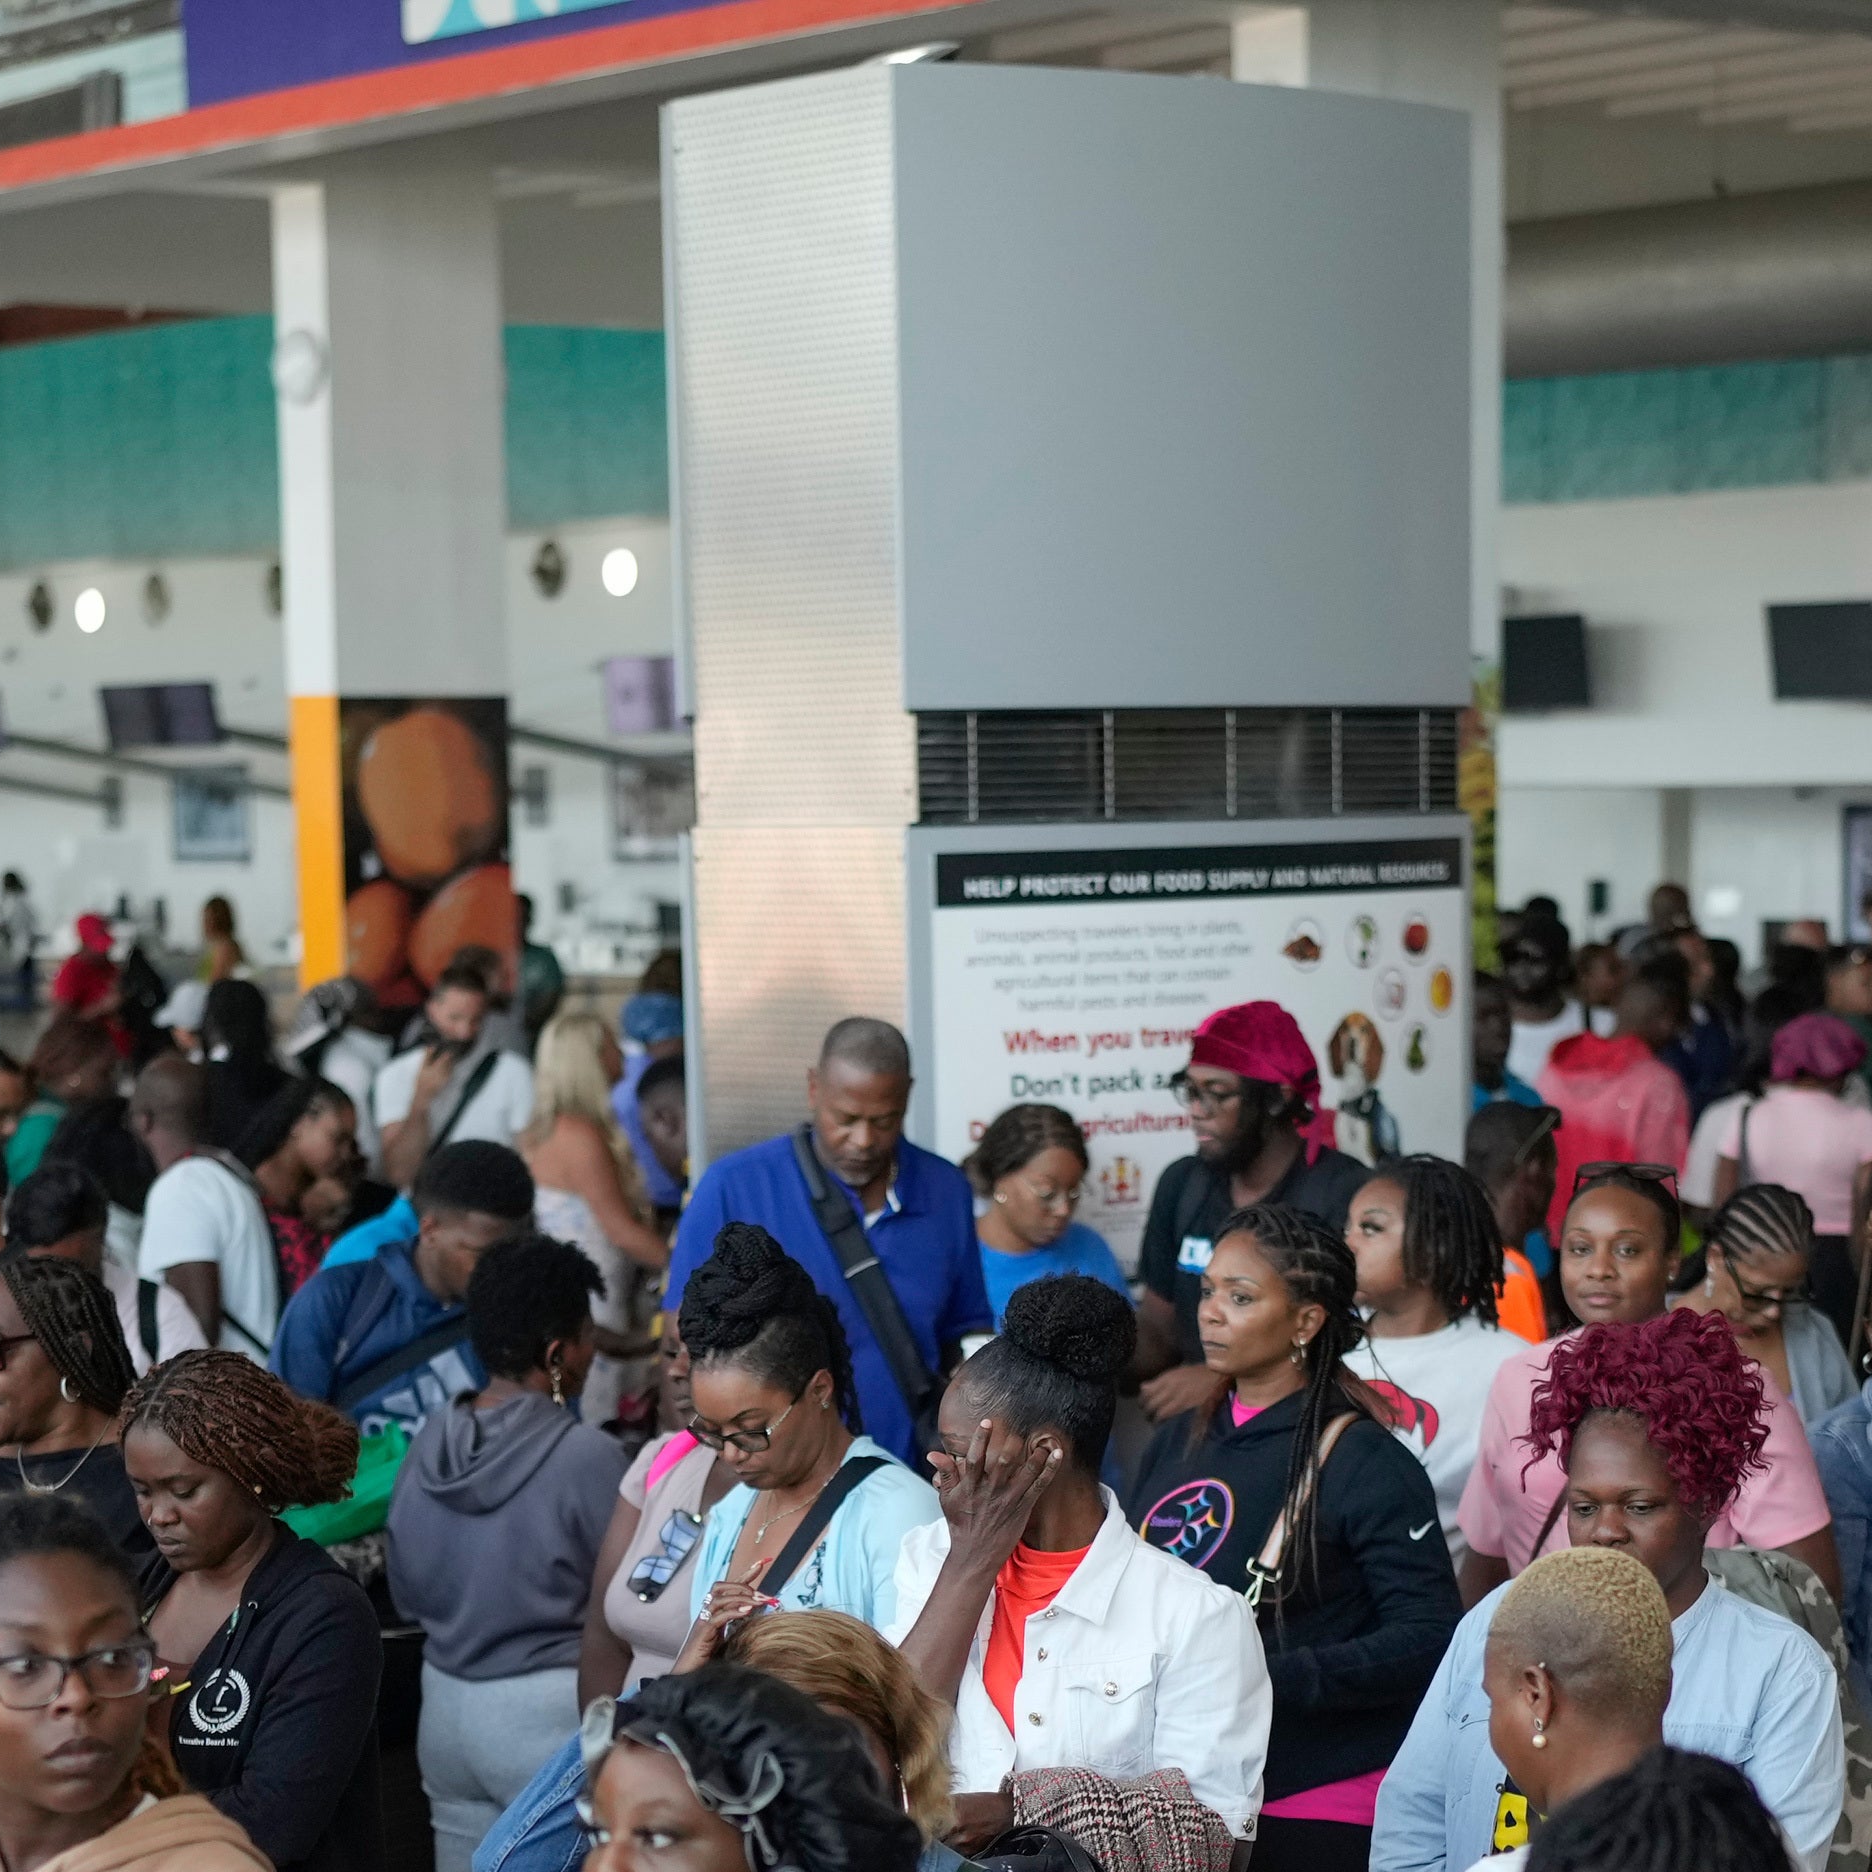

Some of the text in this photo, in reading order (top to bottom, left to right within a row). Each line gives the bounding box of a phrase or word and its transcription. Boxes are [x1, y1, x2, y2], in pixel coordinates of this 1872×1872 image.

[963, 860, 1451, 899] HELP PROTECT OUR FOOD SUPPLY AND NATURAL RESOURCES
[1004, 1026, 1197, 1058] When you trave
[1010, 1073, 1081, 1098] Don't
[1088, 1069, 1142, 1101] pack
[1079, 1111, 1193, 1143] gricultural
[205, 1736, 226, 1747] Board
